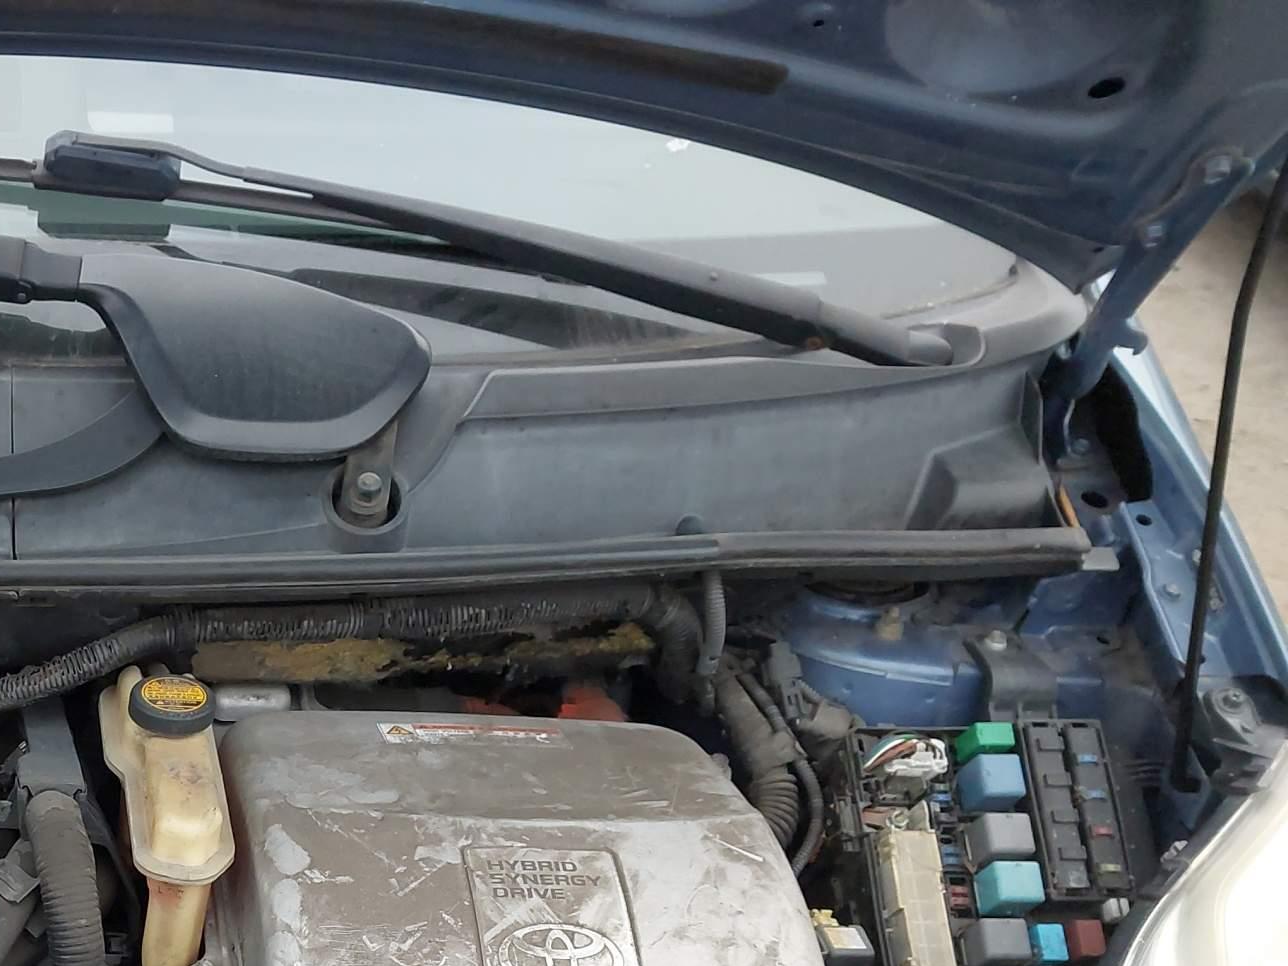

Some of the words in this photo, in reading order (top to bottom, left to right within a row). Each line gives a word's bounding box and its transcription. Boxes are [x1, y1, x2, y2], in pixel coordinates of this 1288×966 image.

[486, 859, 578, 873] HYBRID
[489, 873, 601, 887] SYNERGY
[492, 887, 567, 900] DRIVE
